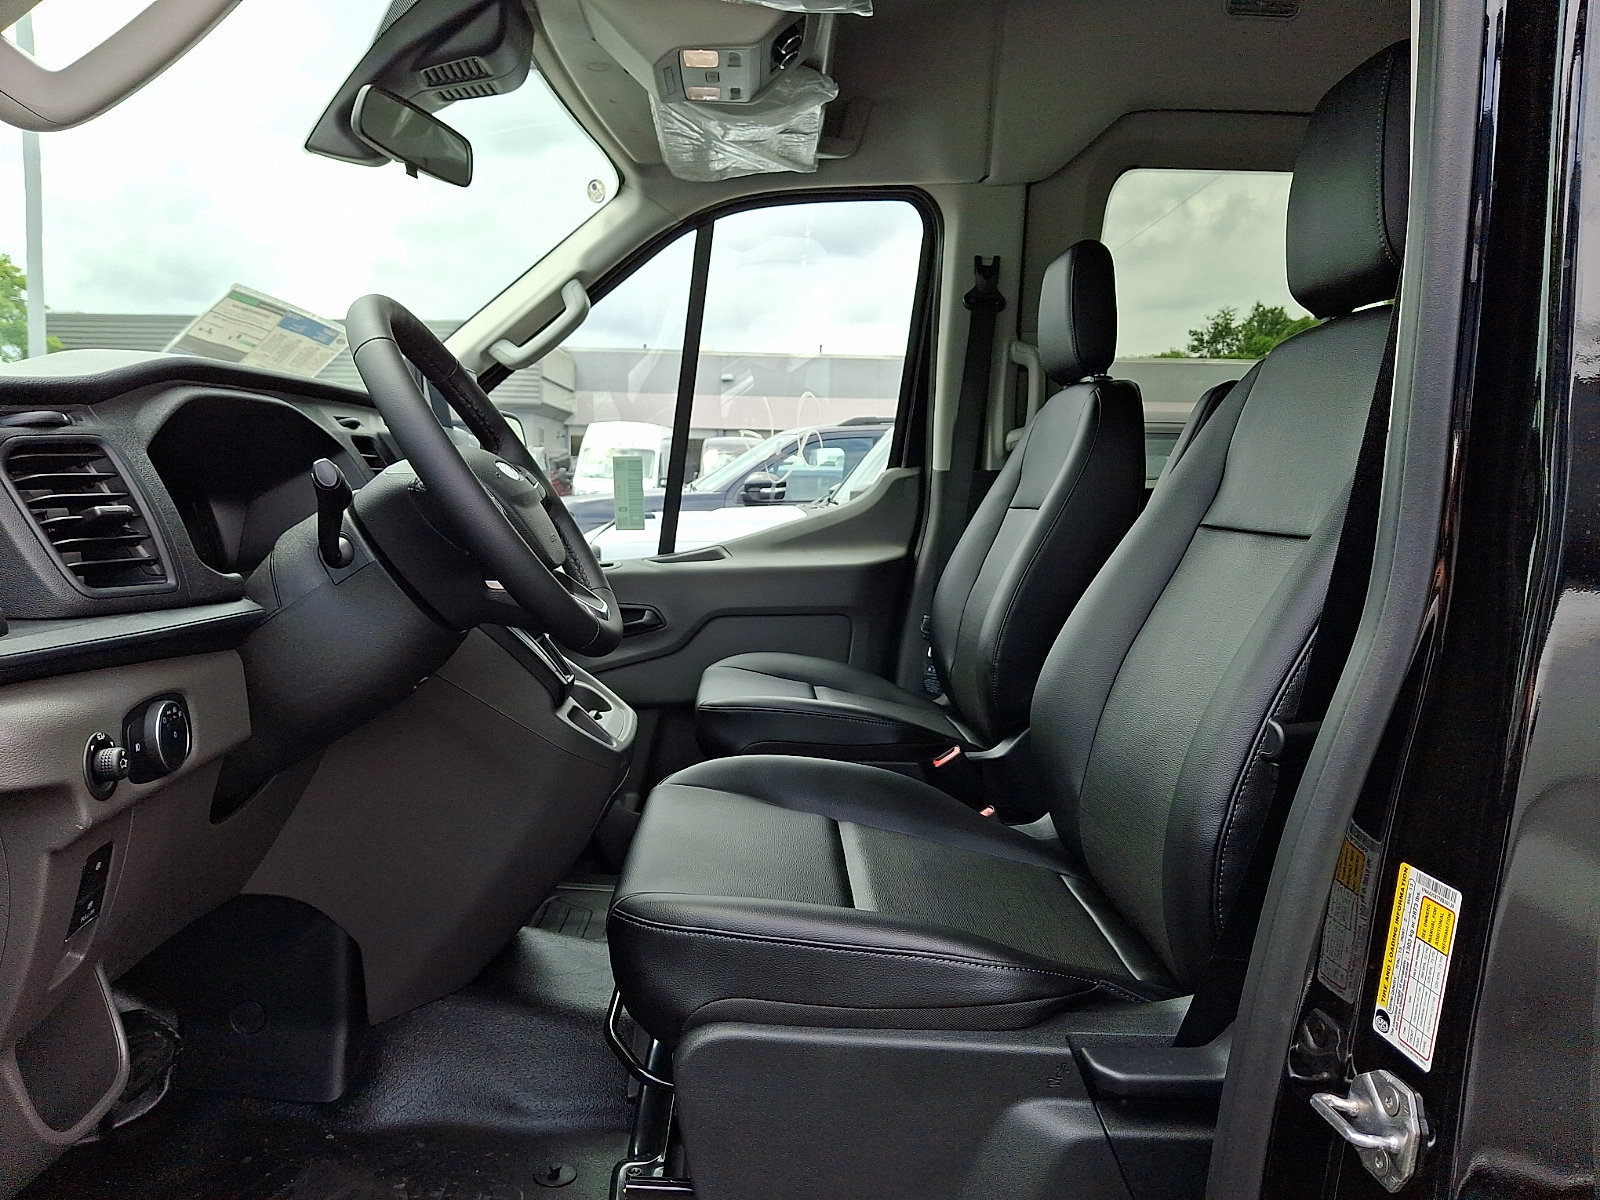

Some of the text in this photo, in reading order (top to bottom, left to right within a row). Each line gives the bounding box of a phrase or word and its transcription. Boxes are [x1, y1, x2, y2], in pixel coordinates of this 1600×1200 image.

[1388, 926, 1398, 963] LOADING
[1395, 867, 1408, 925] INFORMATION
[1409, 929, 1414, 938] kg
[1435, 911, 1444, 946] ADDITIONAL
[1441, 912, 1452, 952] INFORMATION
